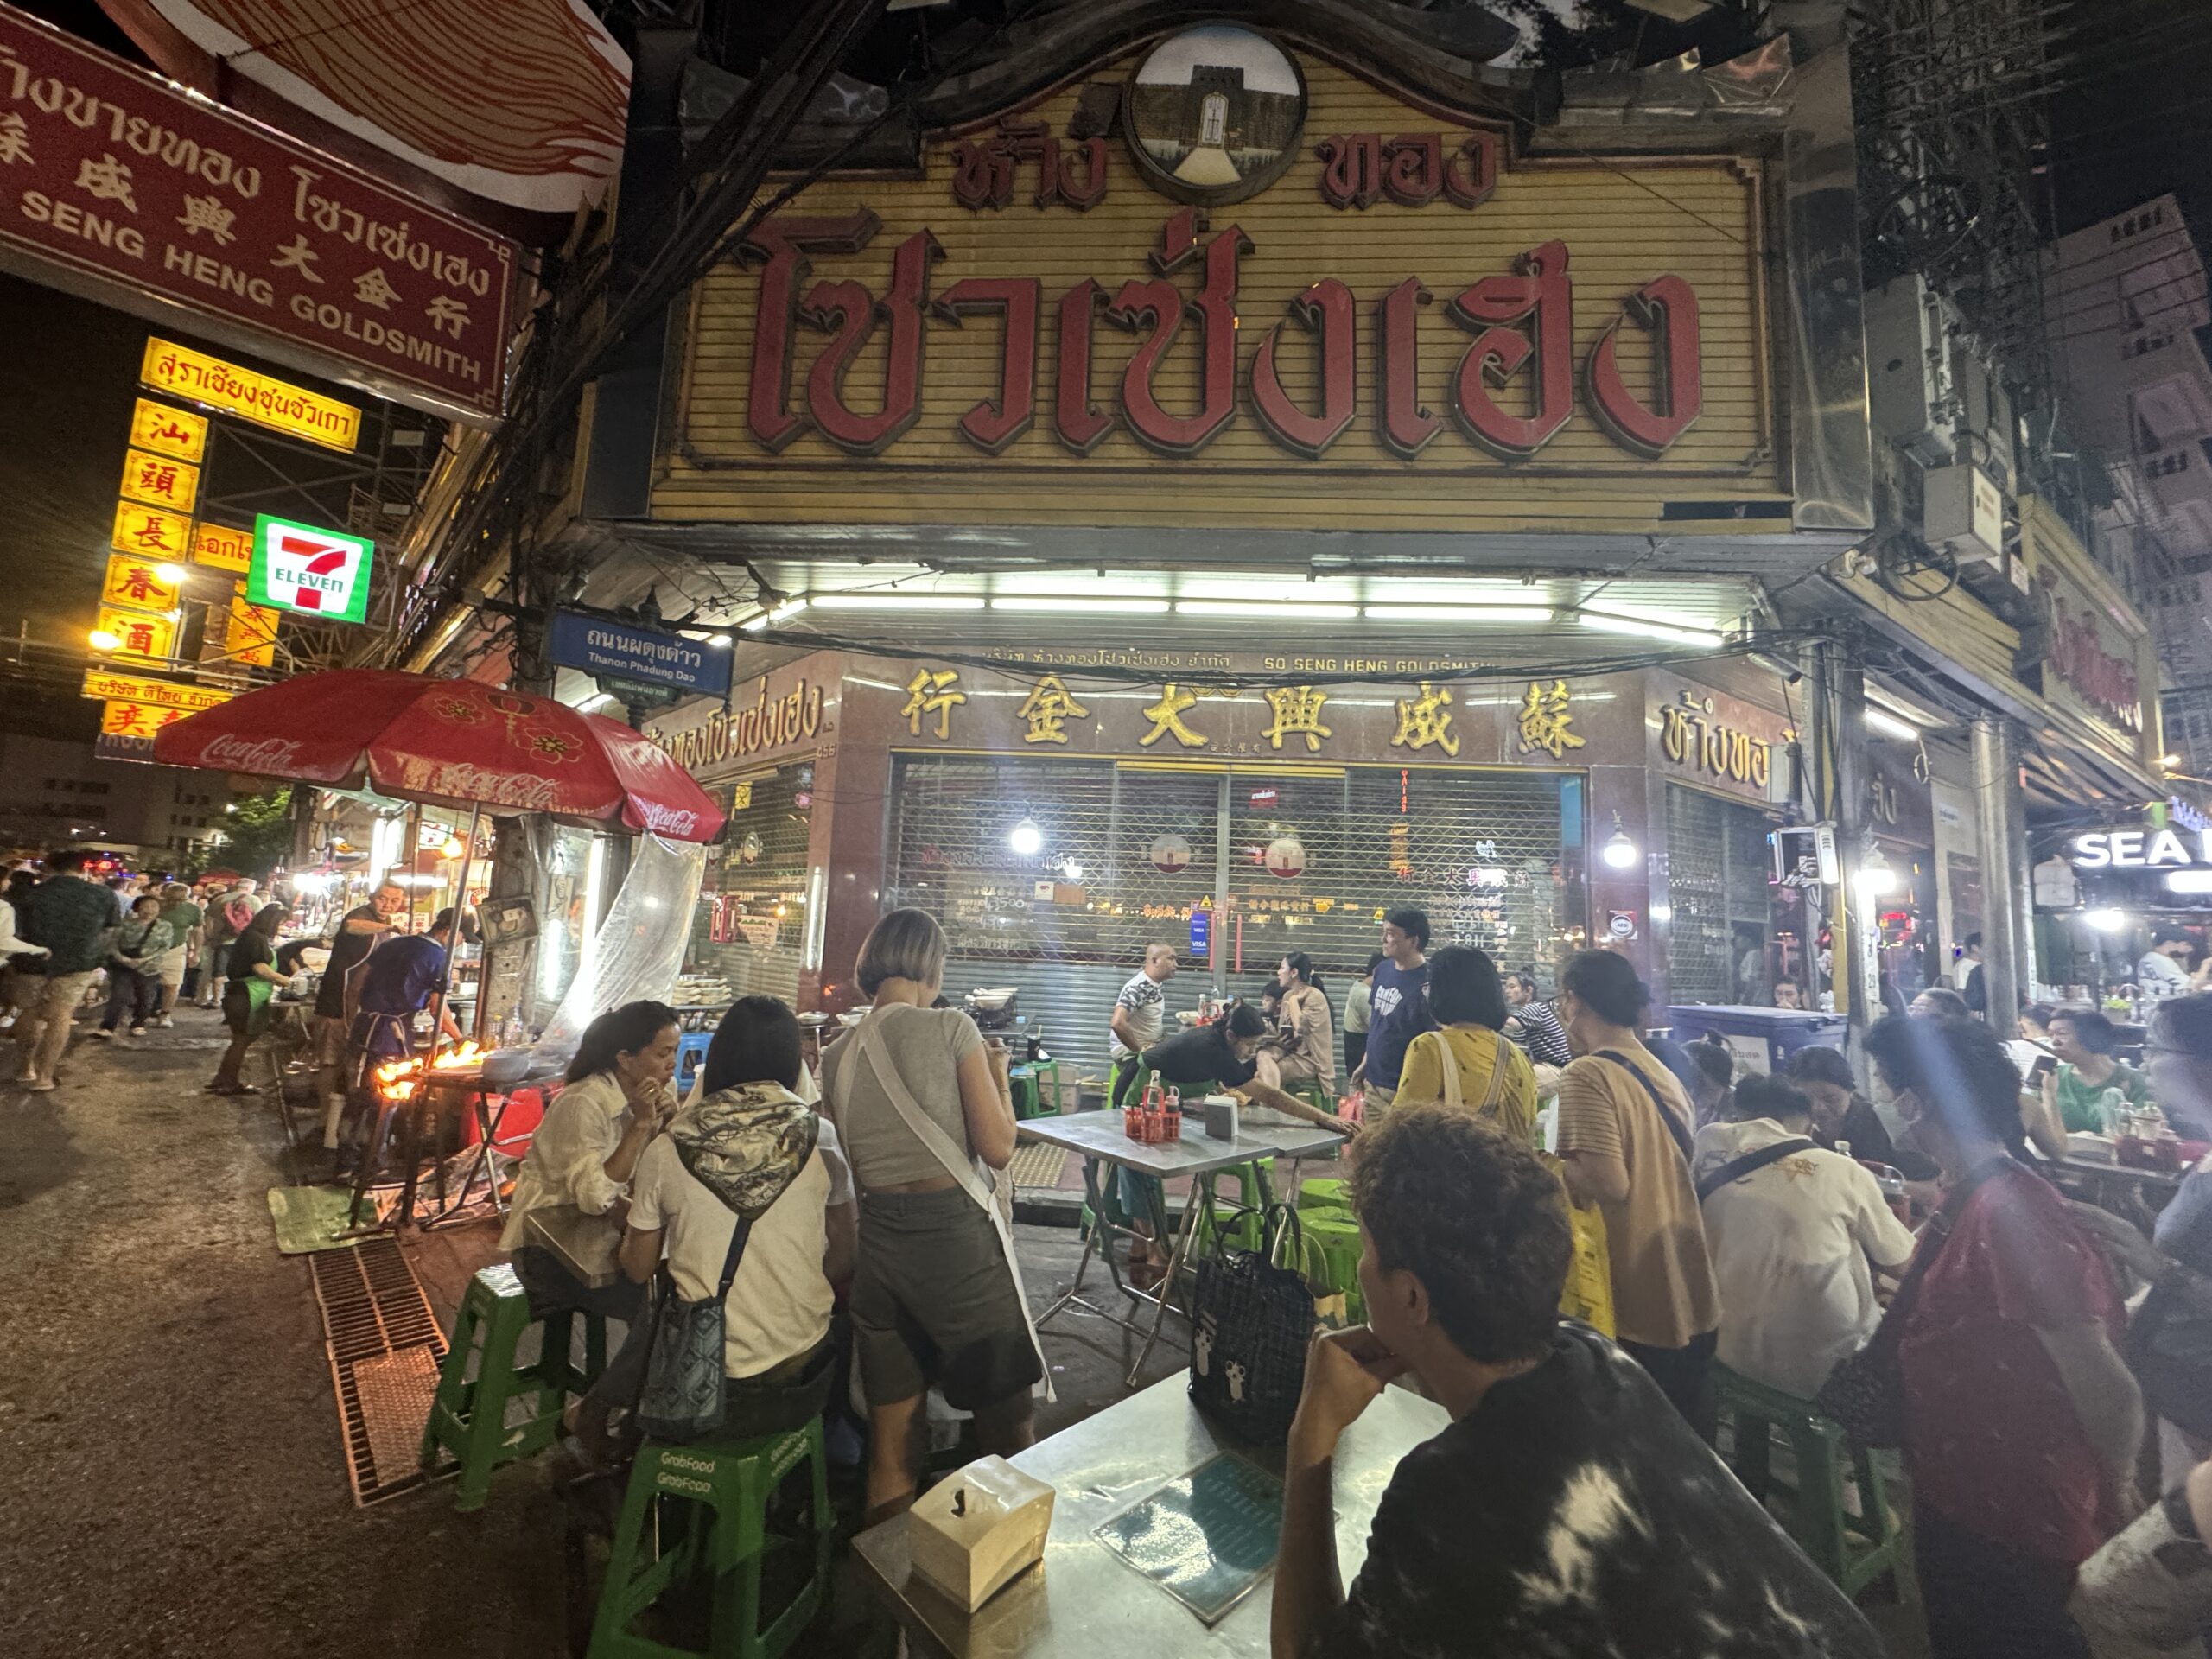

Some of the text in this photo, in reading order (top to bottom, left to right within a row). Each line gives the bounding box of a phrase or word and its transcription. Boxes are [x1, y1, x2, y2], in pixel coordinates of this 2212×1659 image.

[952, 117, 1497, 212] ห้าง ทอง
[21, 190, 481, 382] SENG HENG GOLDSMITH
[587, 629, 702, 668] ถนนผดุงด้าว
[1187, 651, 1230, 667] จำกัด
[1263, 657, 1286, 670] SO
[1294, 658, 1337, 671] SENG
[1344, 659, 1388, 672] HENG
[588, 652, 696, 683] Thanon Phadung Dao
[2073, 830, 2192, 867] SEA
[660, 1451, 715, 1474] GrabFood
